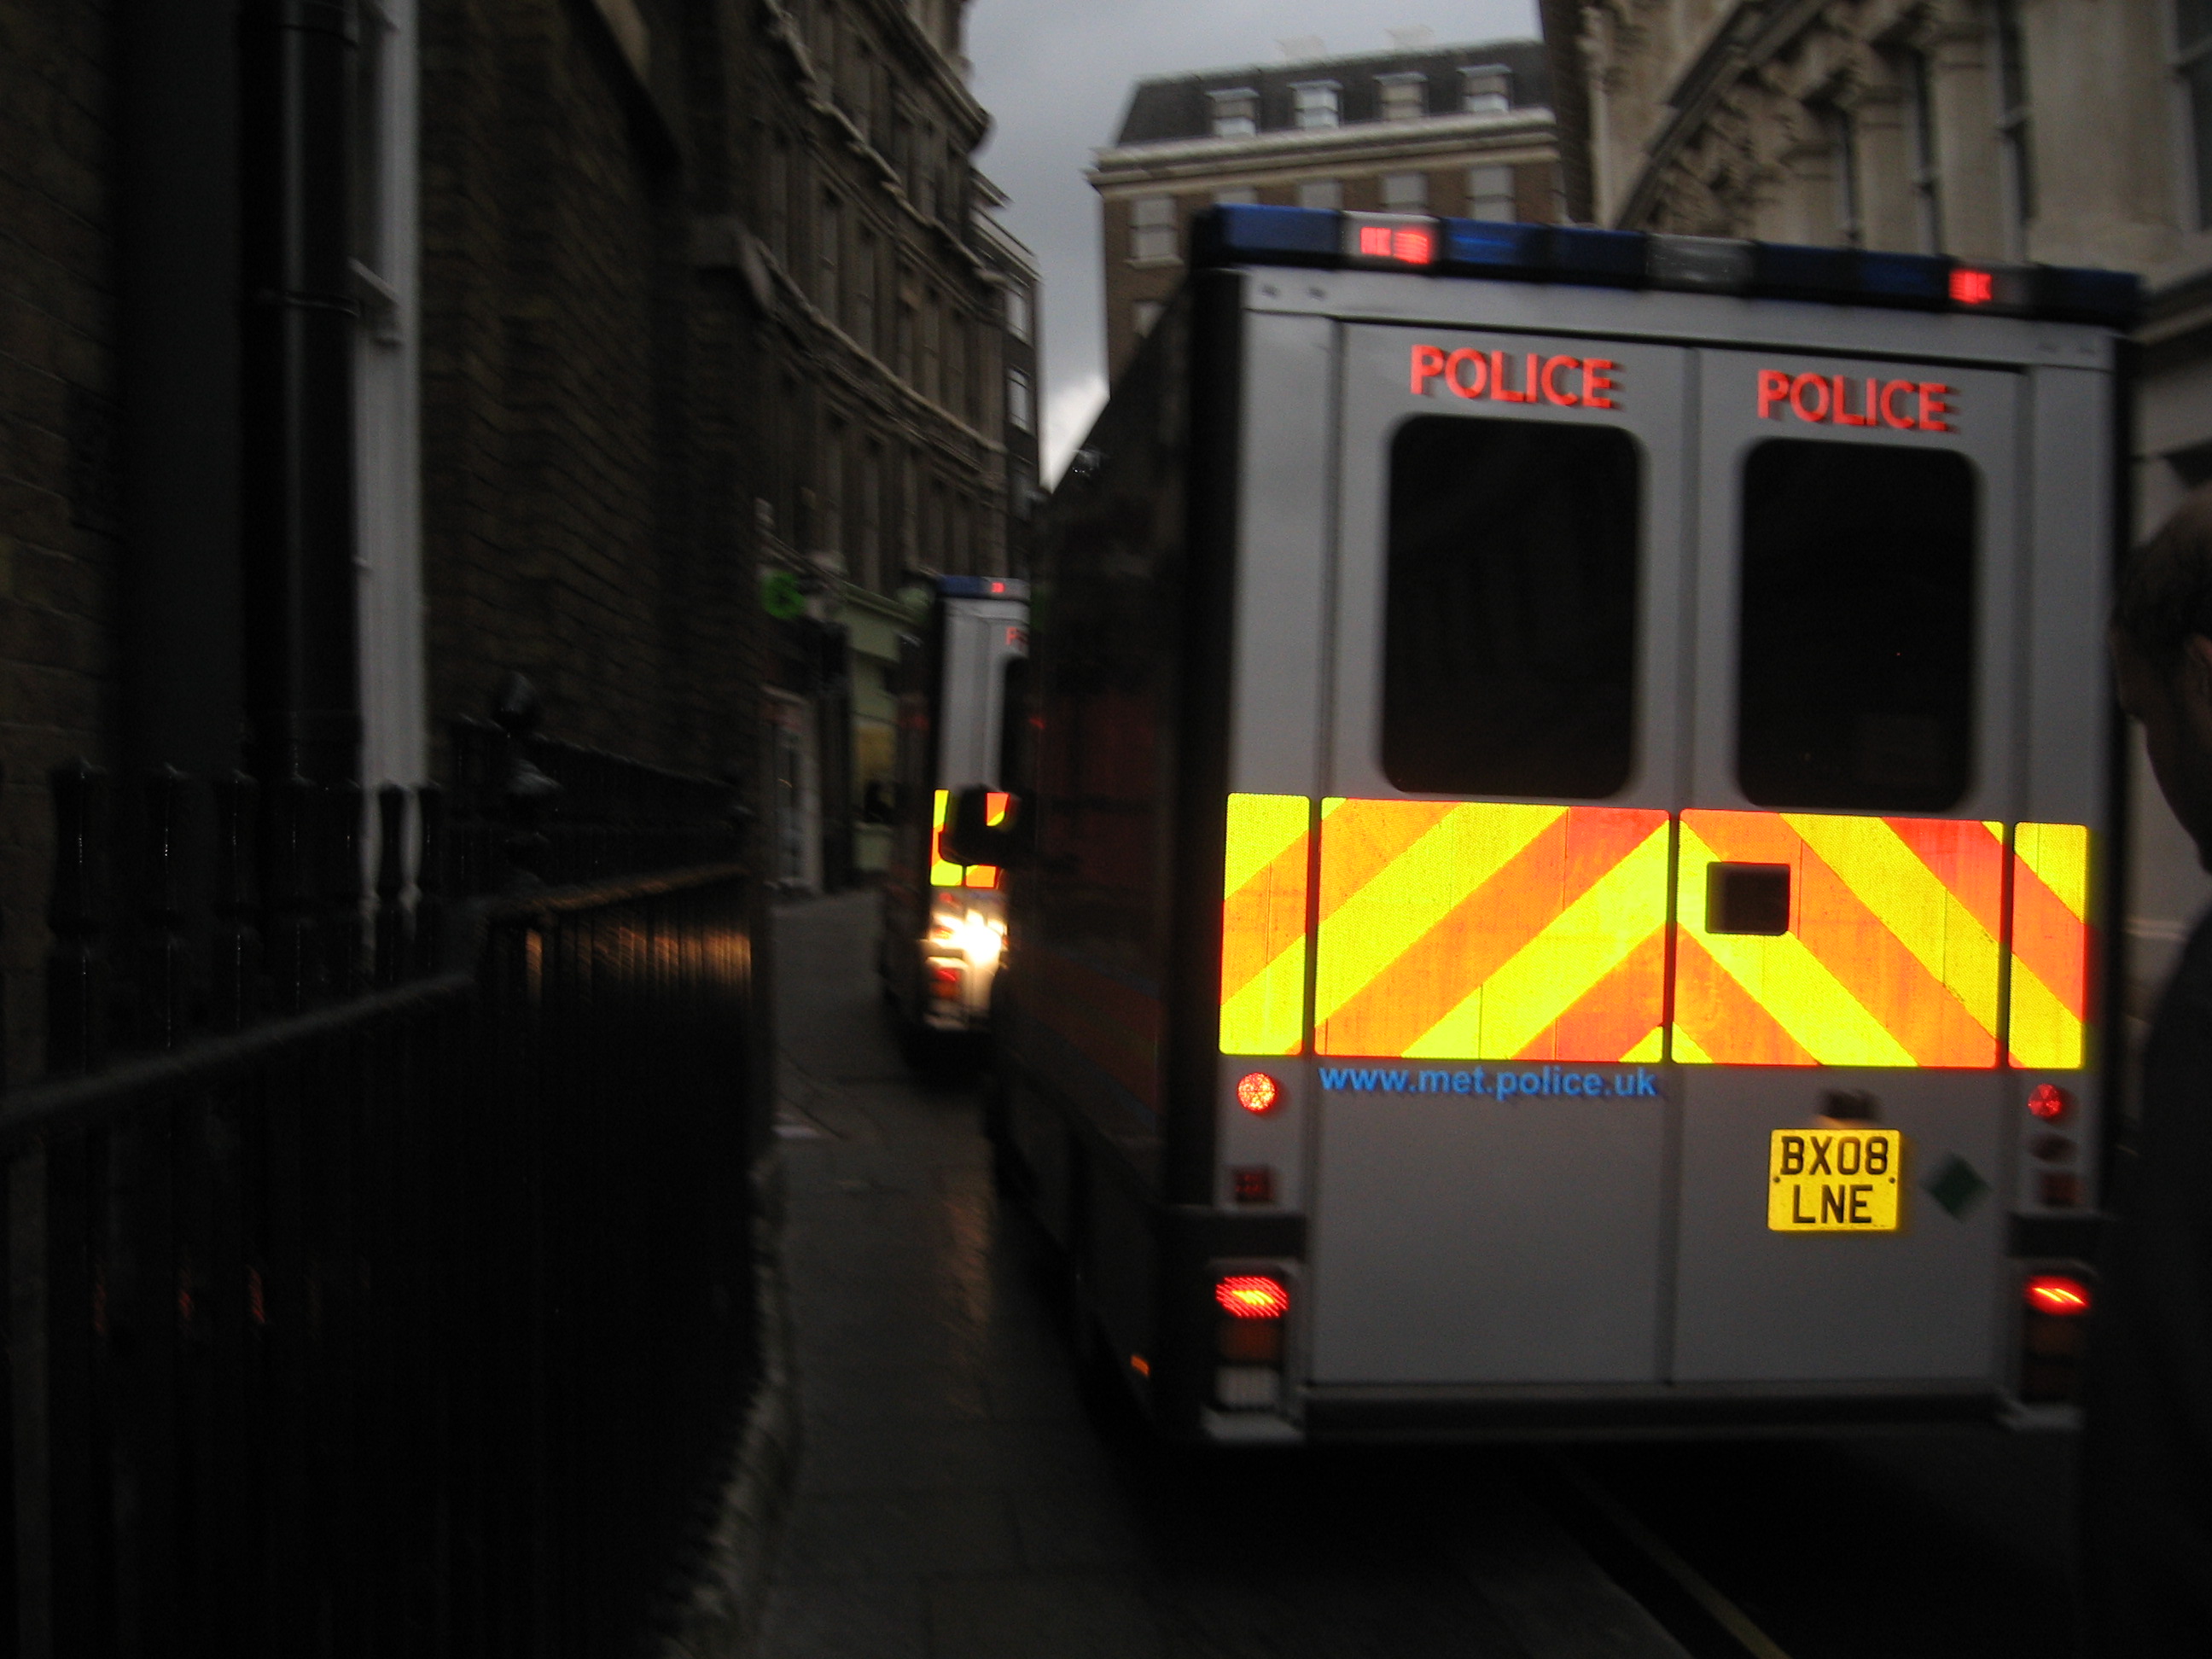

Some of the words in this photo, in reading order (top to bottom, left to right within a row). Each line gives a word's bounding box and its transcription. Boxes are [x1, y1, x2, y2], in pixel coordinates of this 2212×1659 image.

[1410, 344, 1617, 409] POLICE
[1756, 369, 1951, 431] POLICE
[1318, 1067, 1656, 1101] www.met.police.uk
[1780, 1136, 1889, 1175] BX08
[1793, 1185, 1873, 1224] LNE
